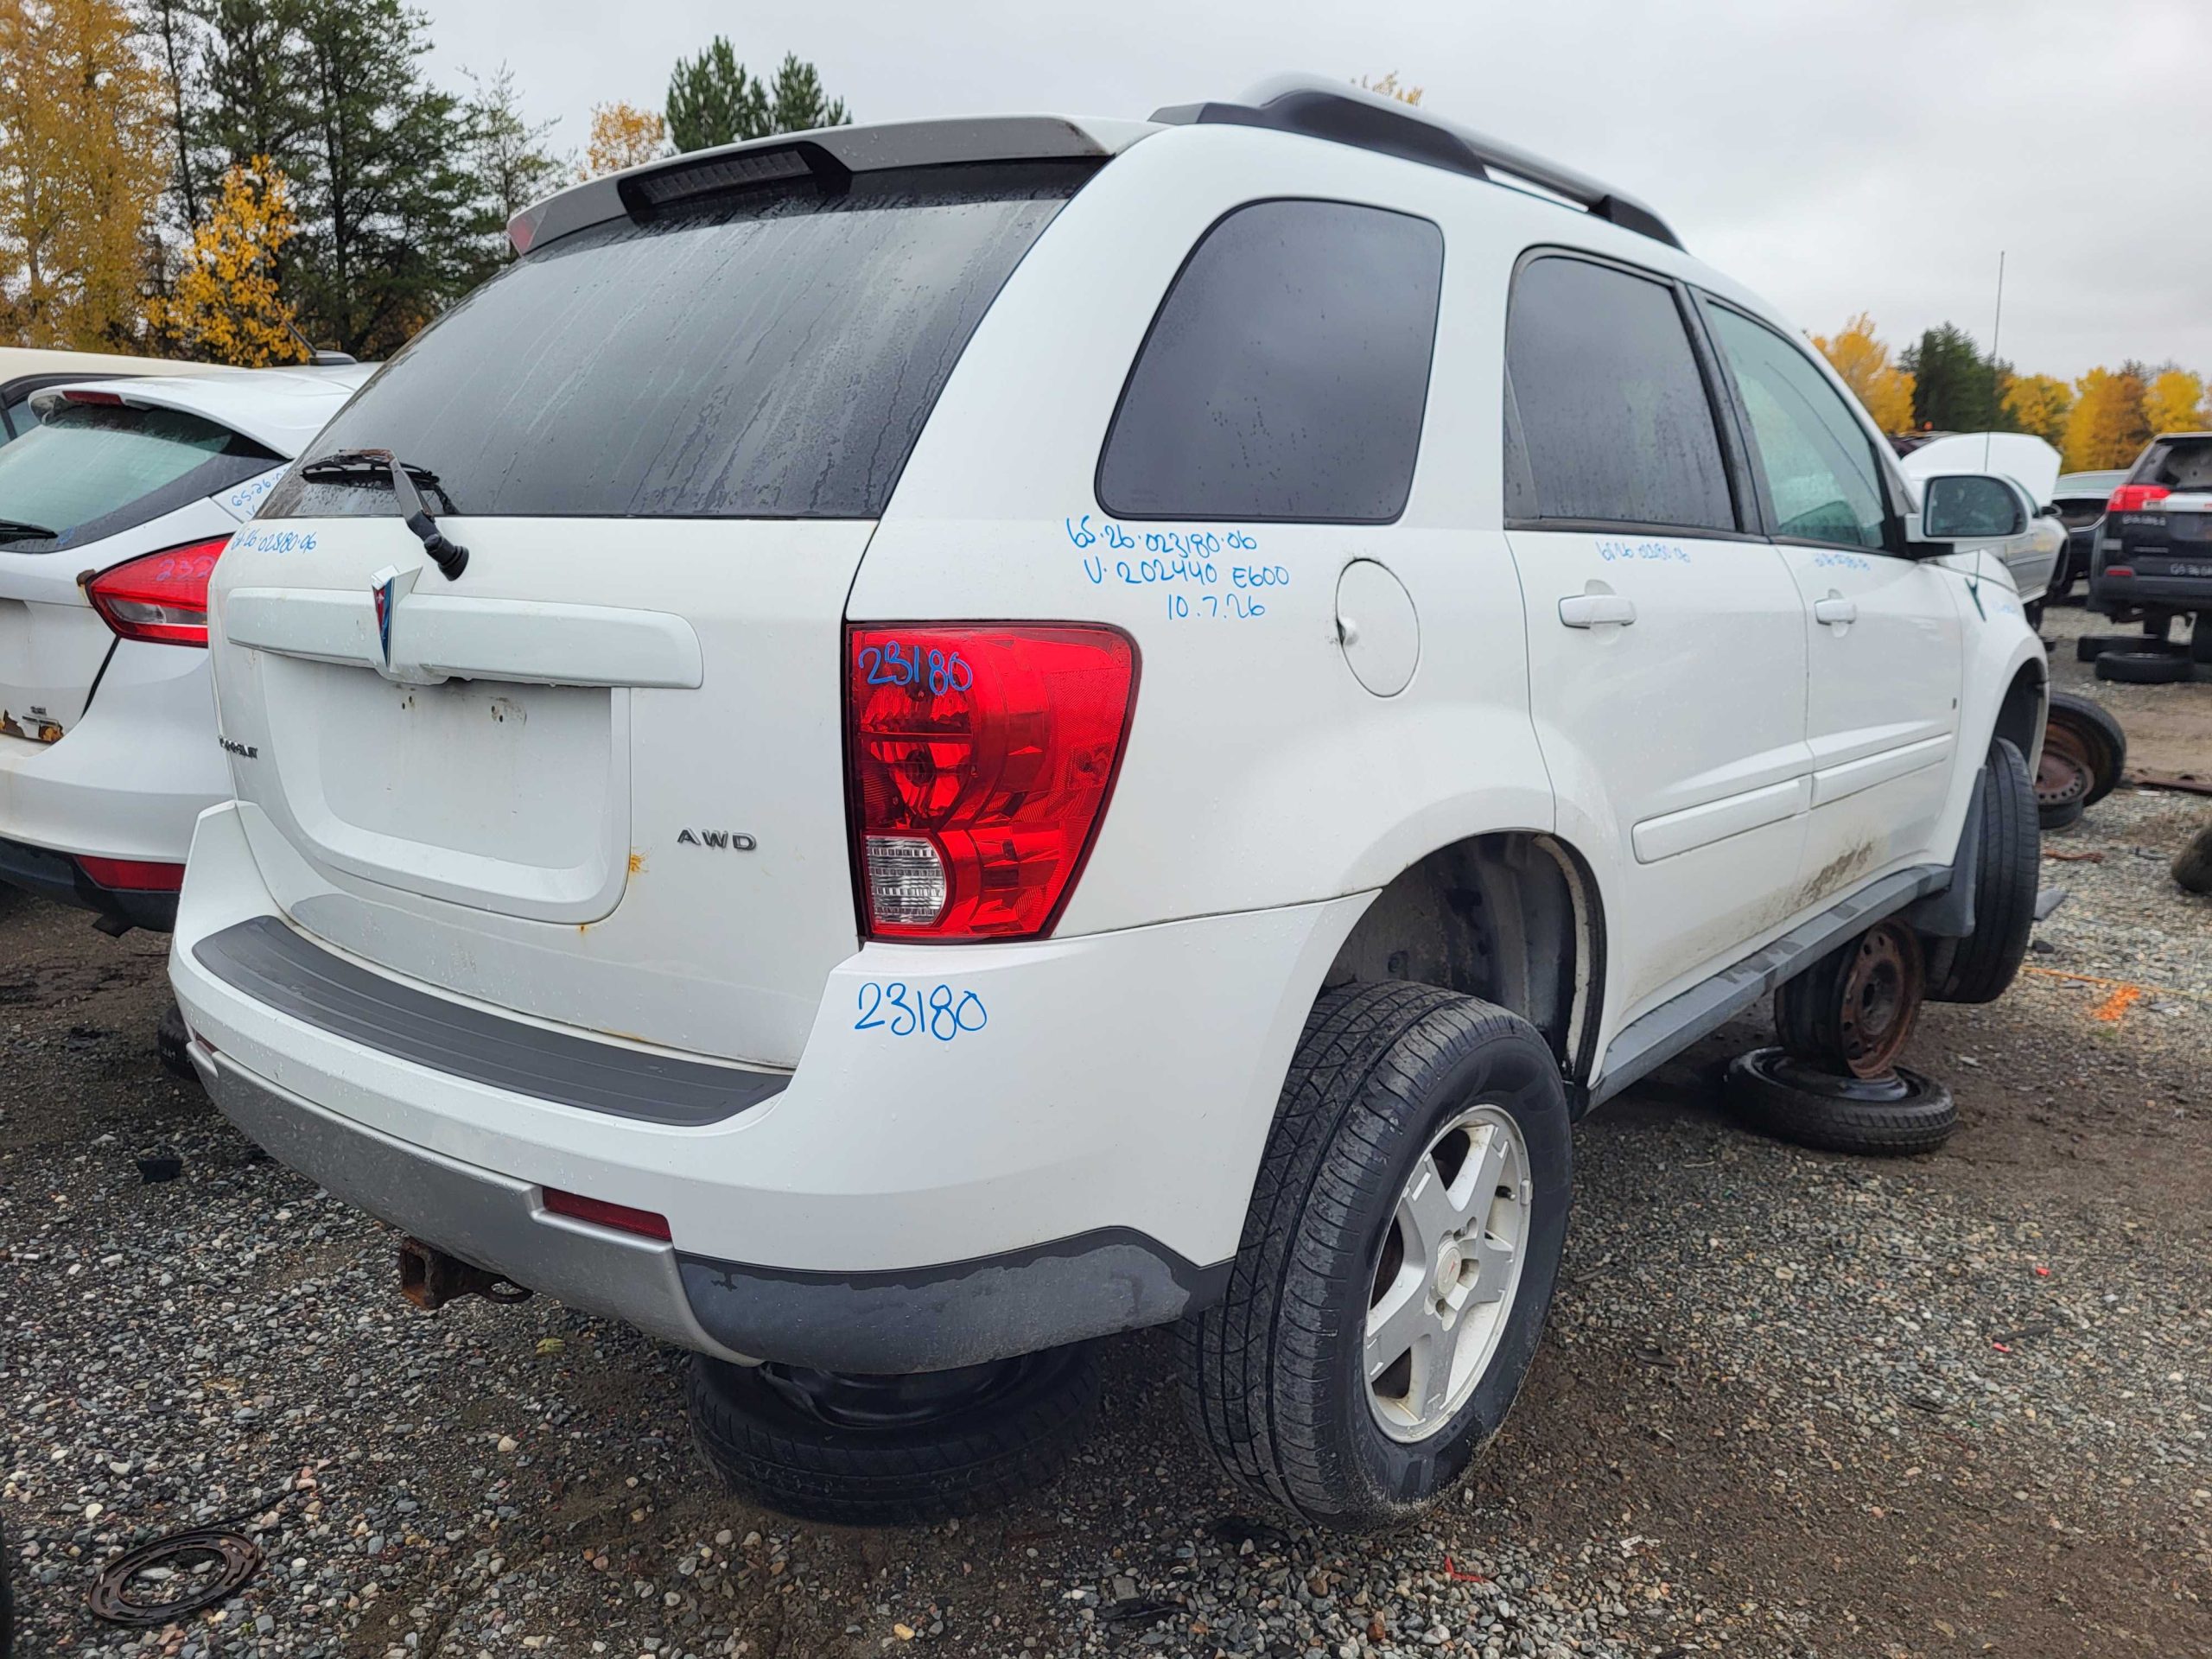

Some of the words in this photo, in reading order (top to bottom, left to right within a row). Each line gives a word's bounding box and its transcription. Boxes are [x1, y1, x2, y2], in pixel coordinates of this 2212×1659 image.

[1232, 566, 1290, 589] E600
[858, 640, 973, 696] 23180
[677, 827, 757, 851] AWD
[854, 982, 988, 1042] 23180
